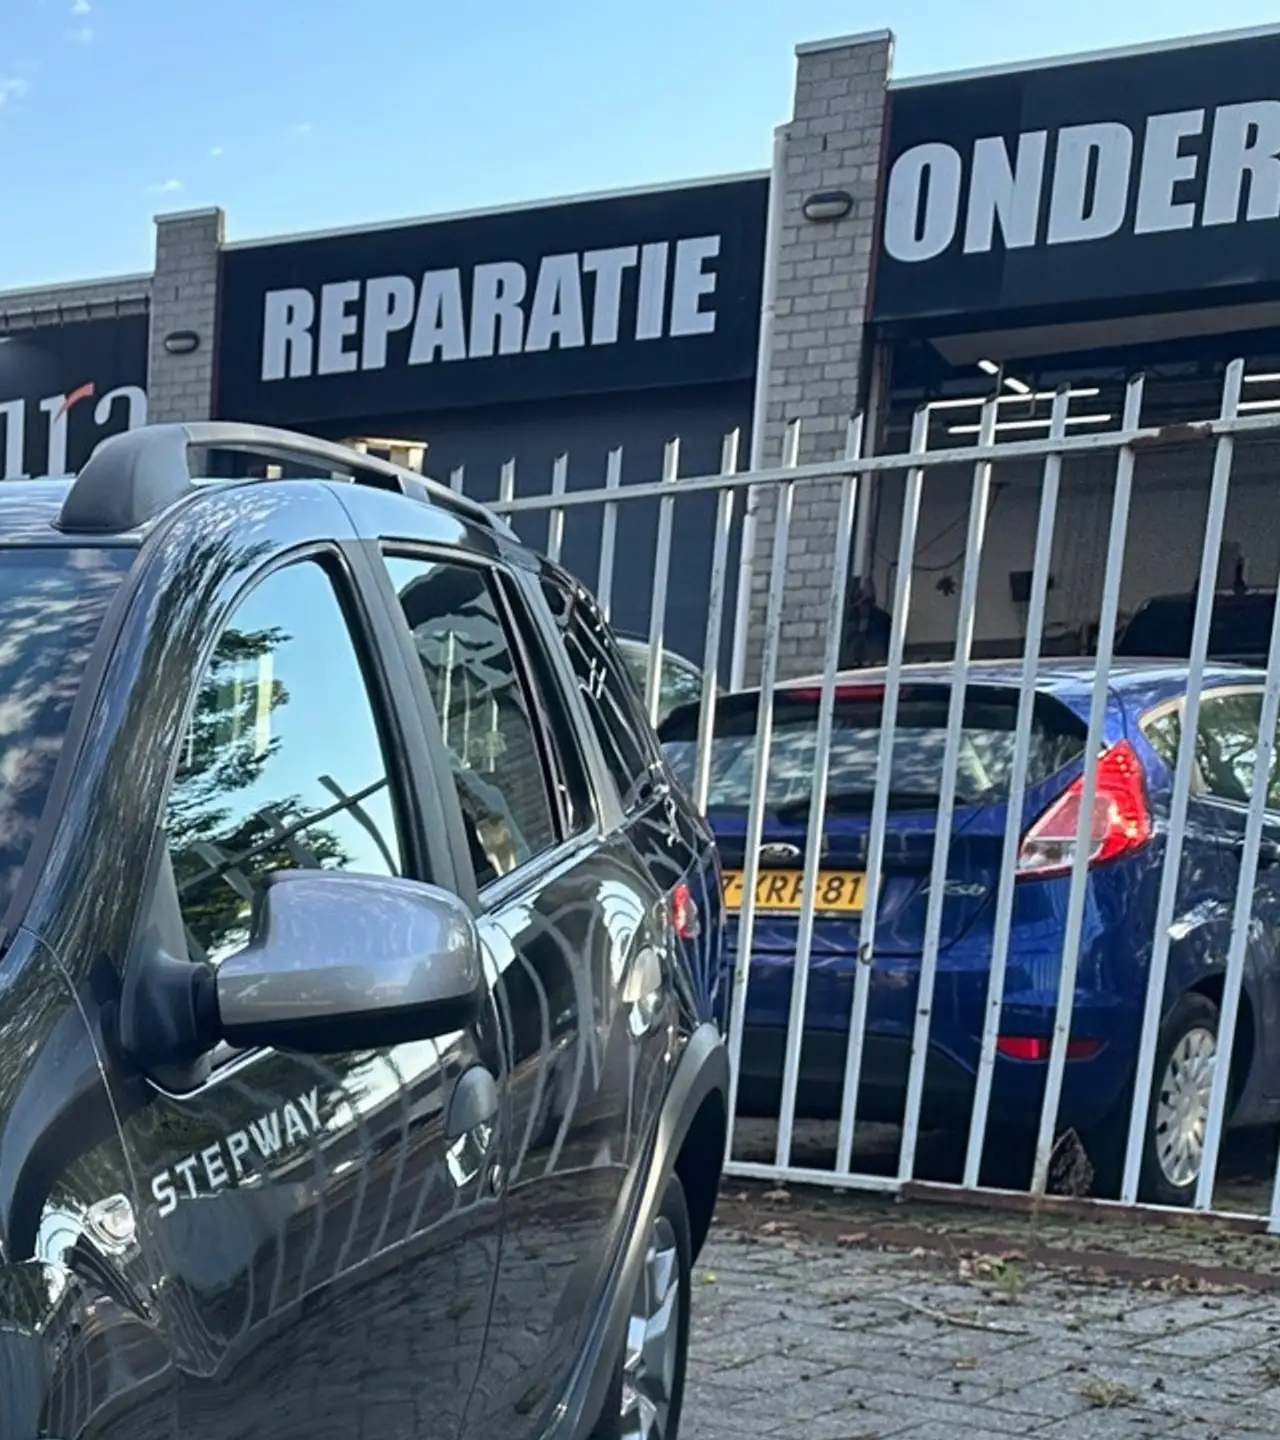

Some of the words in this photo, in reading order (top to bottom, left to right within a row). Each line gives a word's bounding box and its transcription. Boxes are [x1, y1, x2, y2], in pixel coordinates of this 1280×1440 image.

[884, 100, 1280, 262] ONDER
[261, 235, 721, 381] REPARATIE
[151, 1086, 324, 1218] STEPWAY
